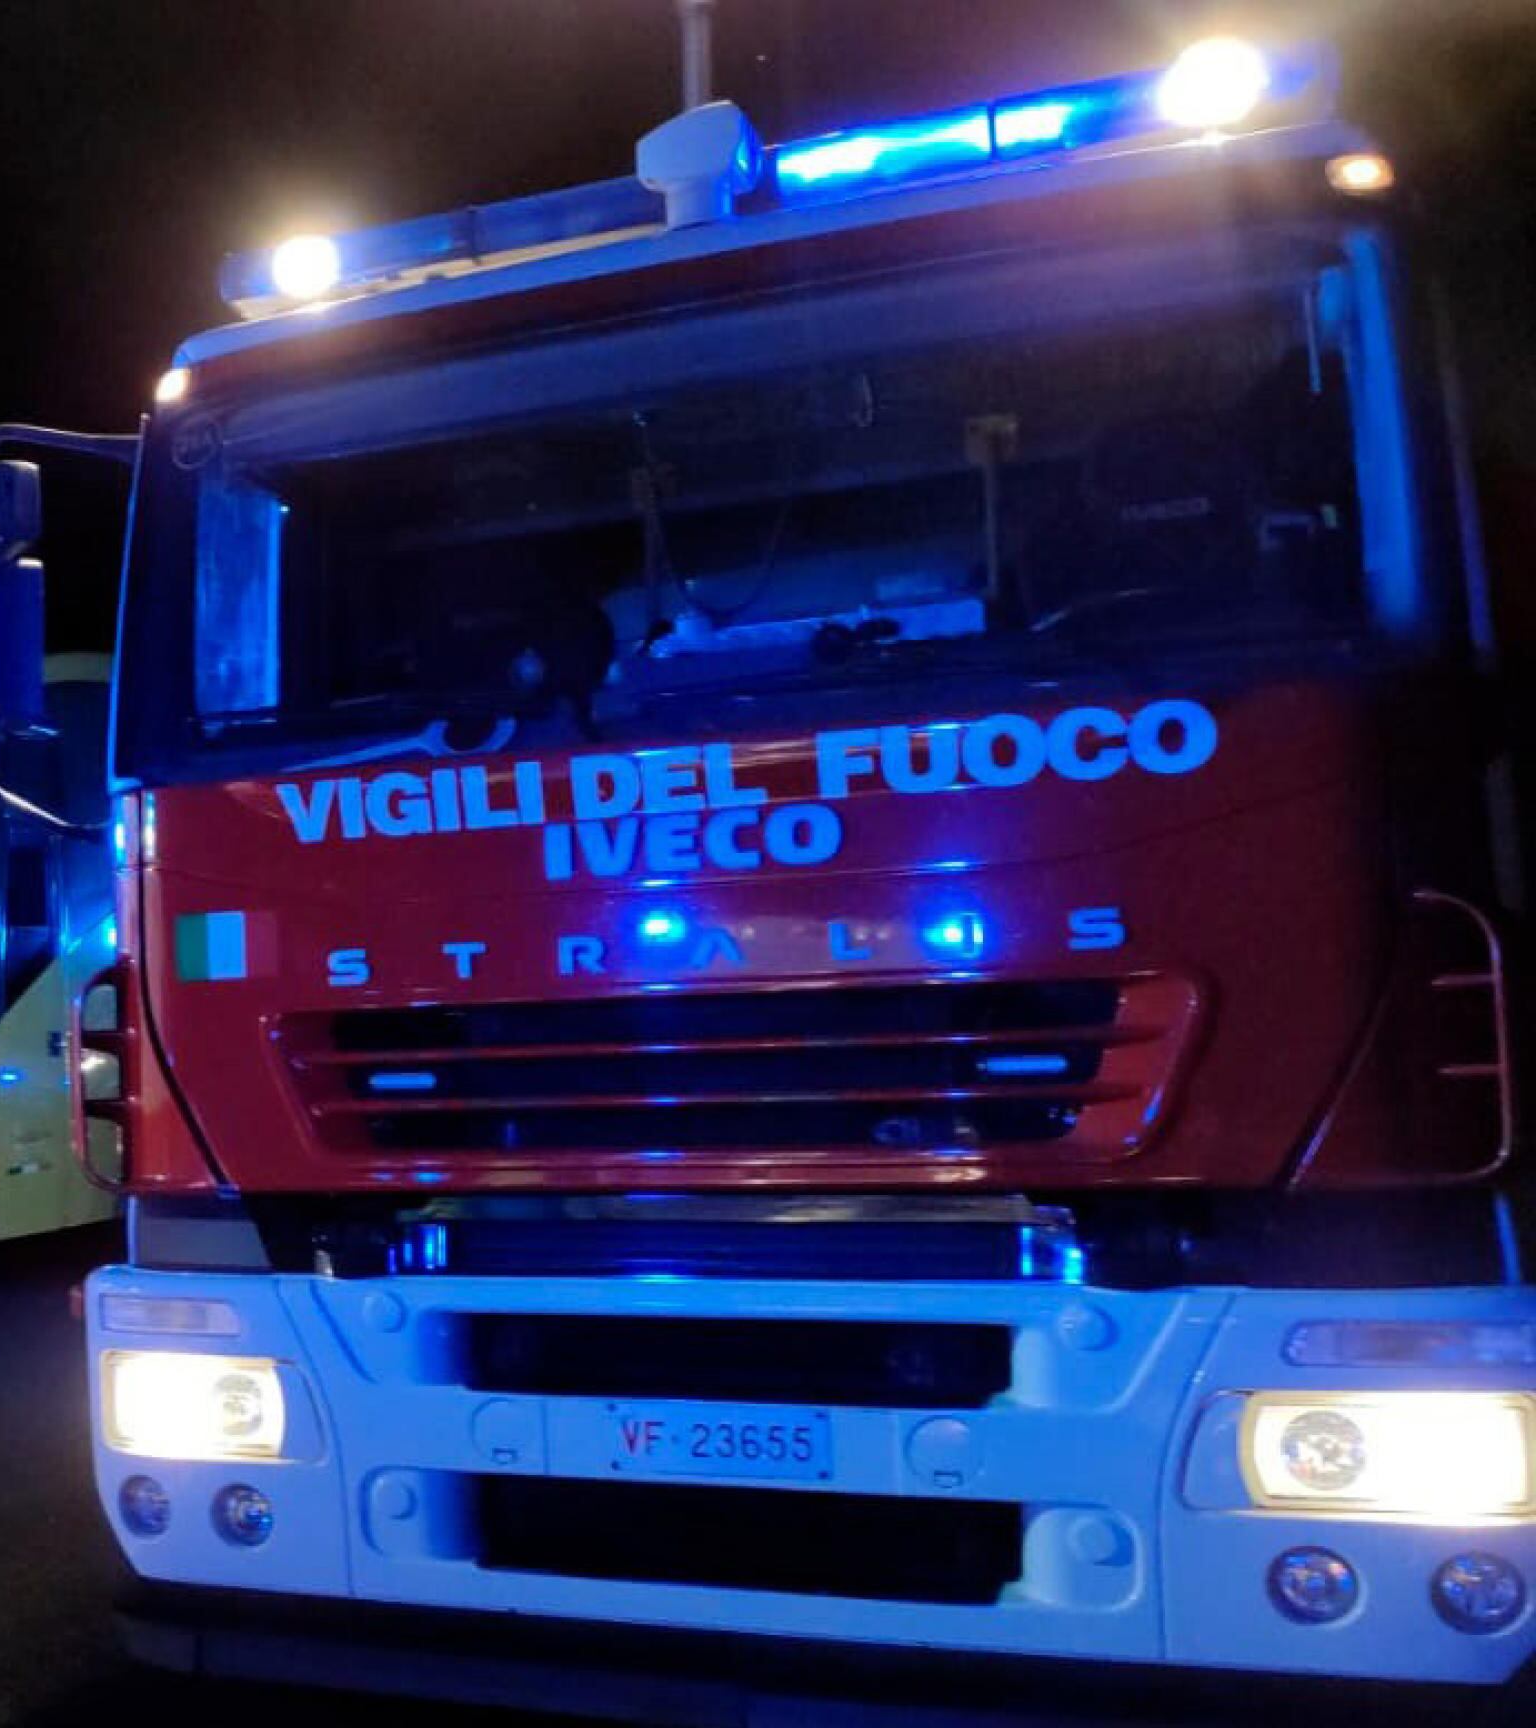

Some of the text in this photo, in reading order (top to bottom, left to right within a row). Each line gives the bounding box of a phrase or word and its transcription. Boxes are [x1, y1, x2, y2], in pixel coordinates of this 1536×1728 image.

[275, 698, 1219, 844] VIGILI DEL FUOCO
[543, 803, 843, 882] IVECO
[620, 1420, 813, 1463] VF 23655
